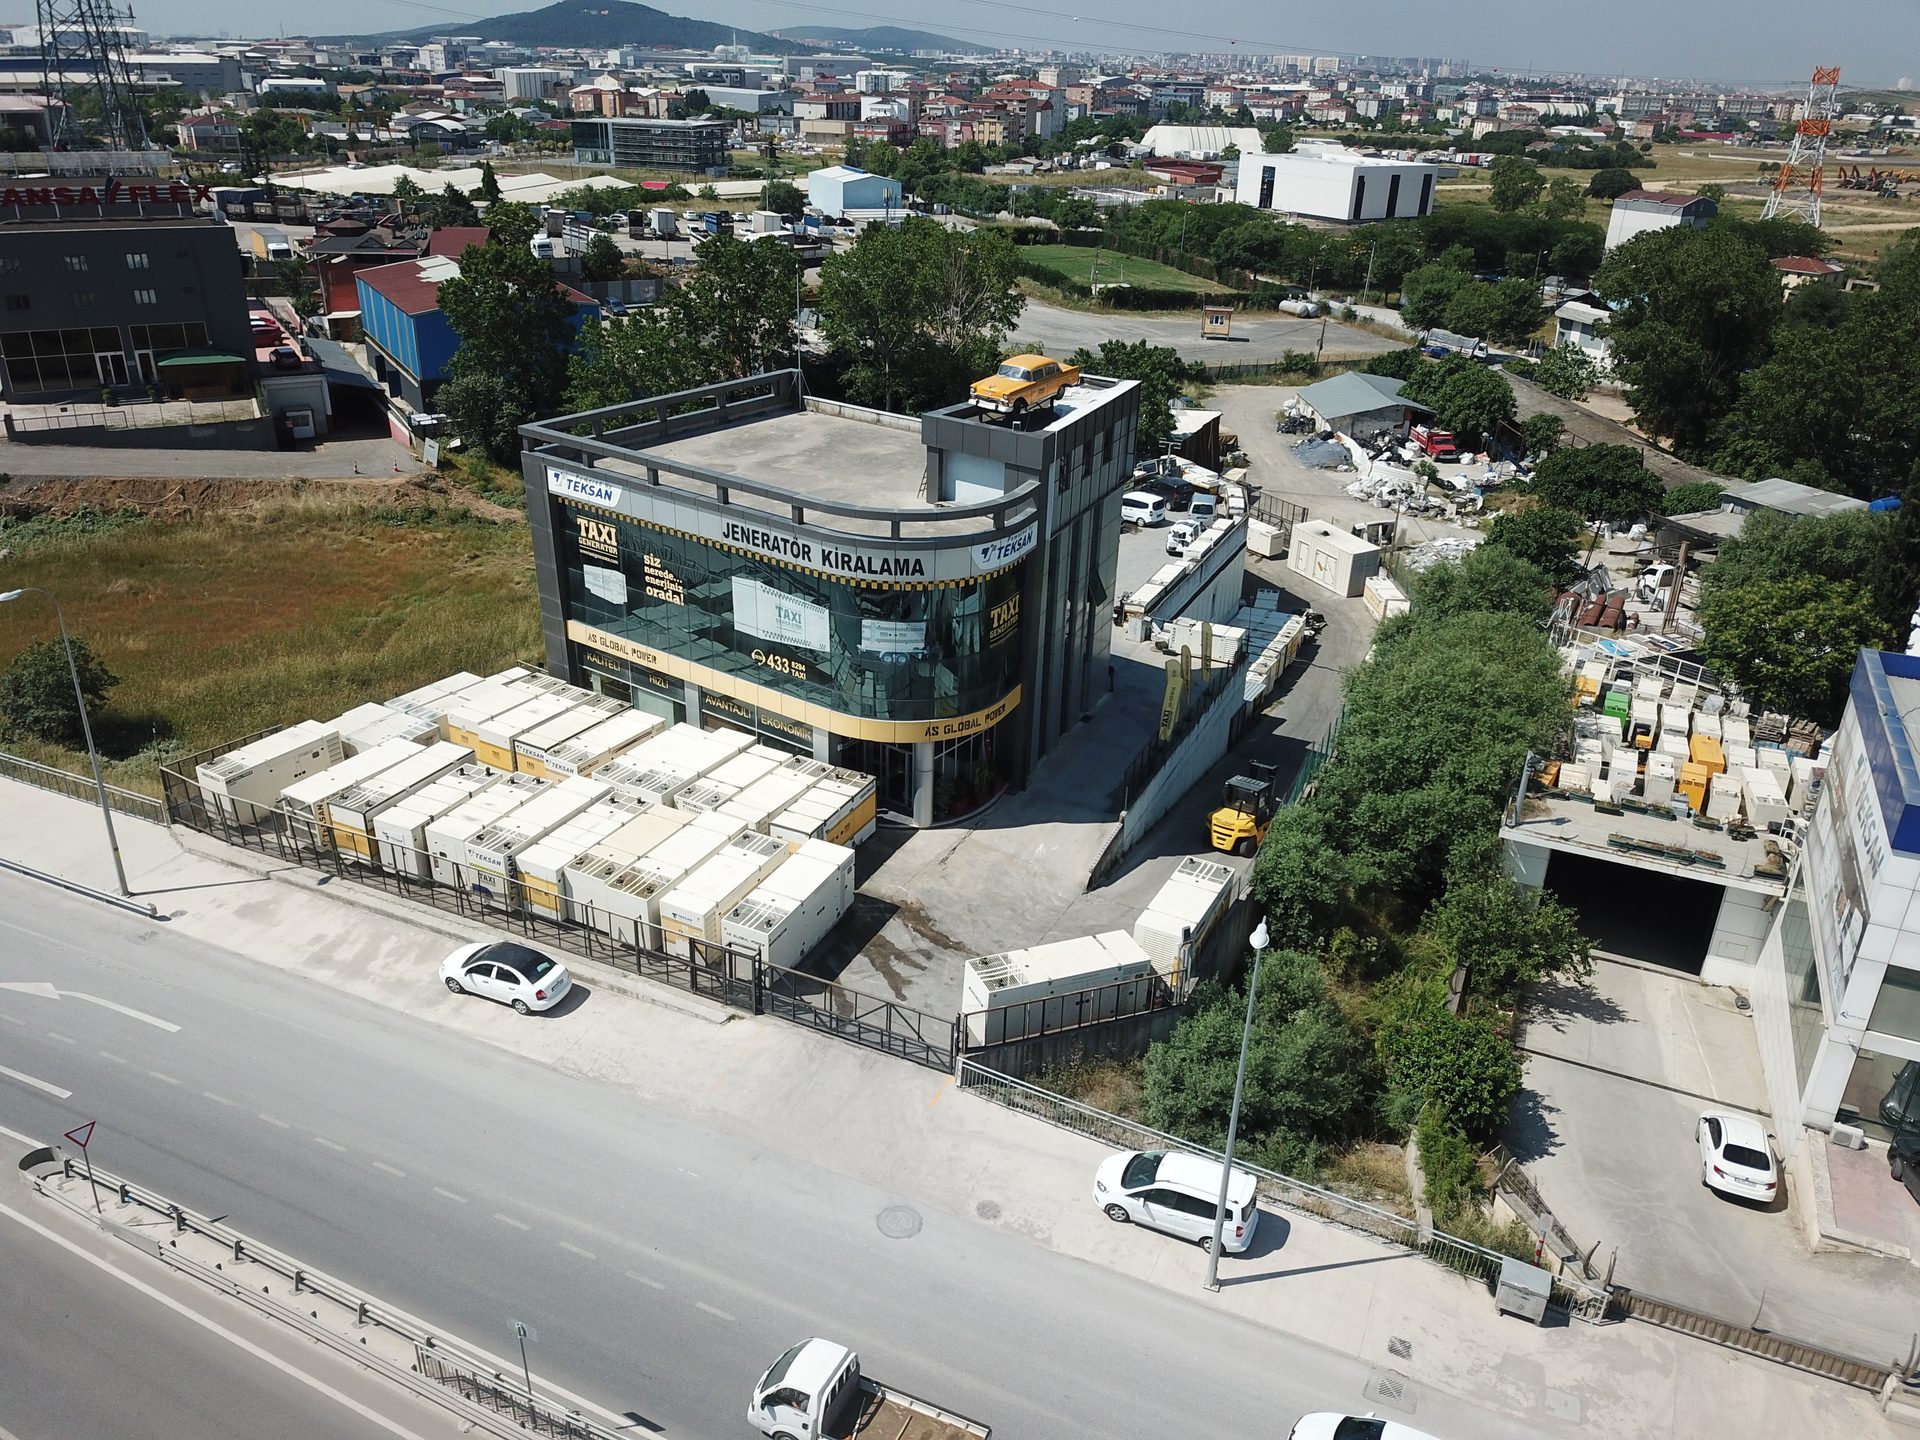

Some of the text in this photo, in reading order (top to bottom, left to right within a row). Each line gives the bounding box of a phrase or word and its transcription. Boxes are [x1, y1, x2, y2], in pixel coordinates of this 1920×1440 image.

[567, 479, 612, 501] TEKSAN
[577, 518, 617, 546] TAXI
[578, 536, 618, 555] GENERATOR
[722, 522, 925, 576] JENERATÖR KİRALAMA
[997, 530, 1033, 559] TEKSAN
[644, 553, 661, 568] siz
[645, 575, 684, 593] enerjiniz
[646, 586, 684, 606] orada!
[775, 605, 802, 625] TAXI
[990, 595, 1020, 628] TAXI
[588, 633, 657, 664] AS GLOBAL POWER
[767, 654, 789, 673] 433
[705, 695, 752, 719] AVANTAJLI
[760, 714, 812, 741] EKONOMİK
[924, 726, 939, 737] AS
[943, 717, 981, 735] GLOBAL
[522, 748, 544, 759] TEKSAN
[552, 762, 575, 774] TEKSAN
[1855, 780, 1884, 880] TEKSAN
[476, 853, 502, 866] TEKSAN
[479, 874, 496, 884] TAXI
